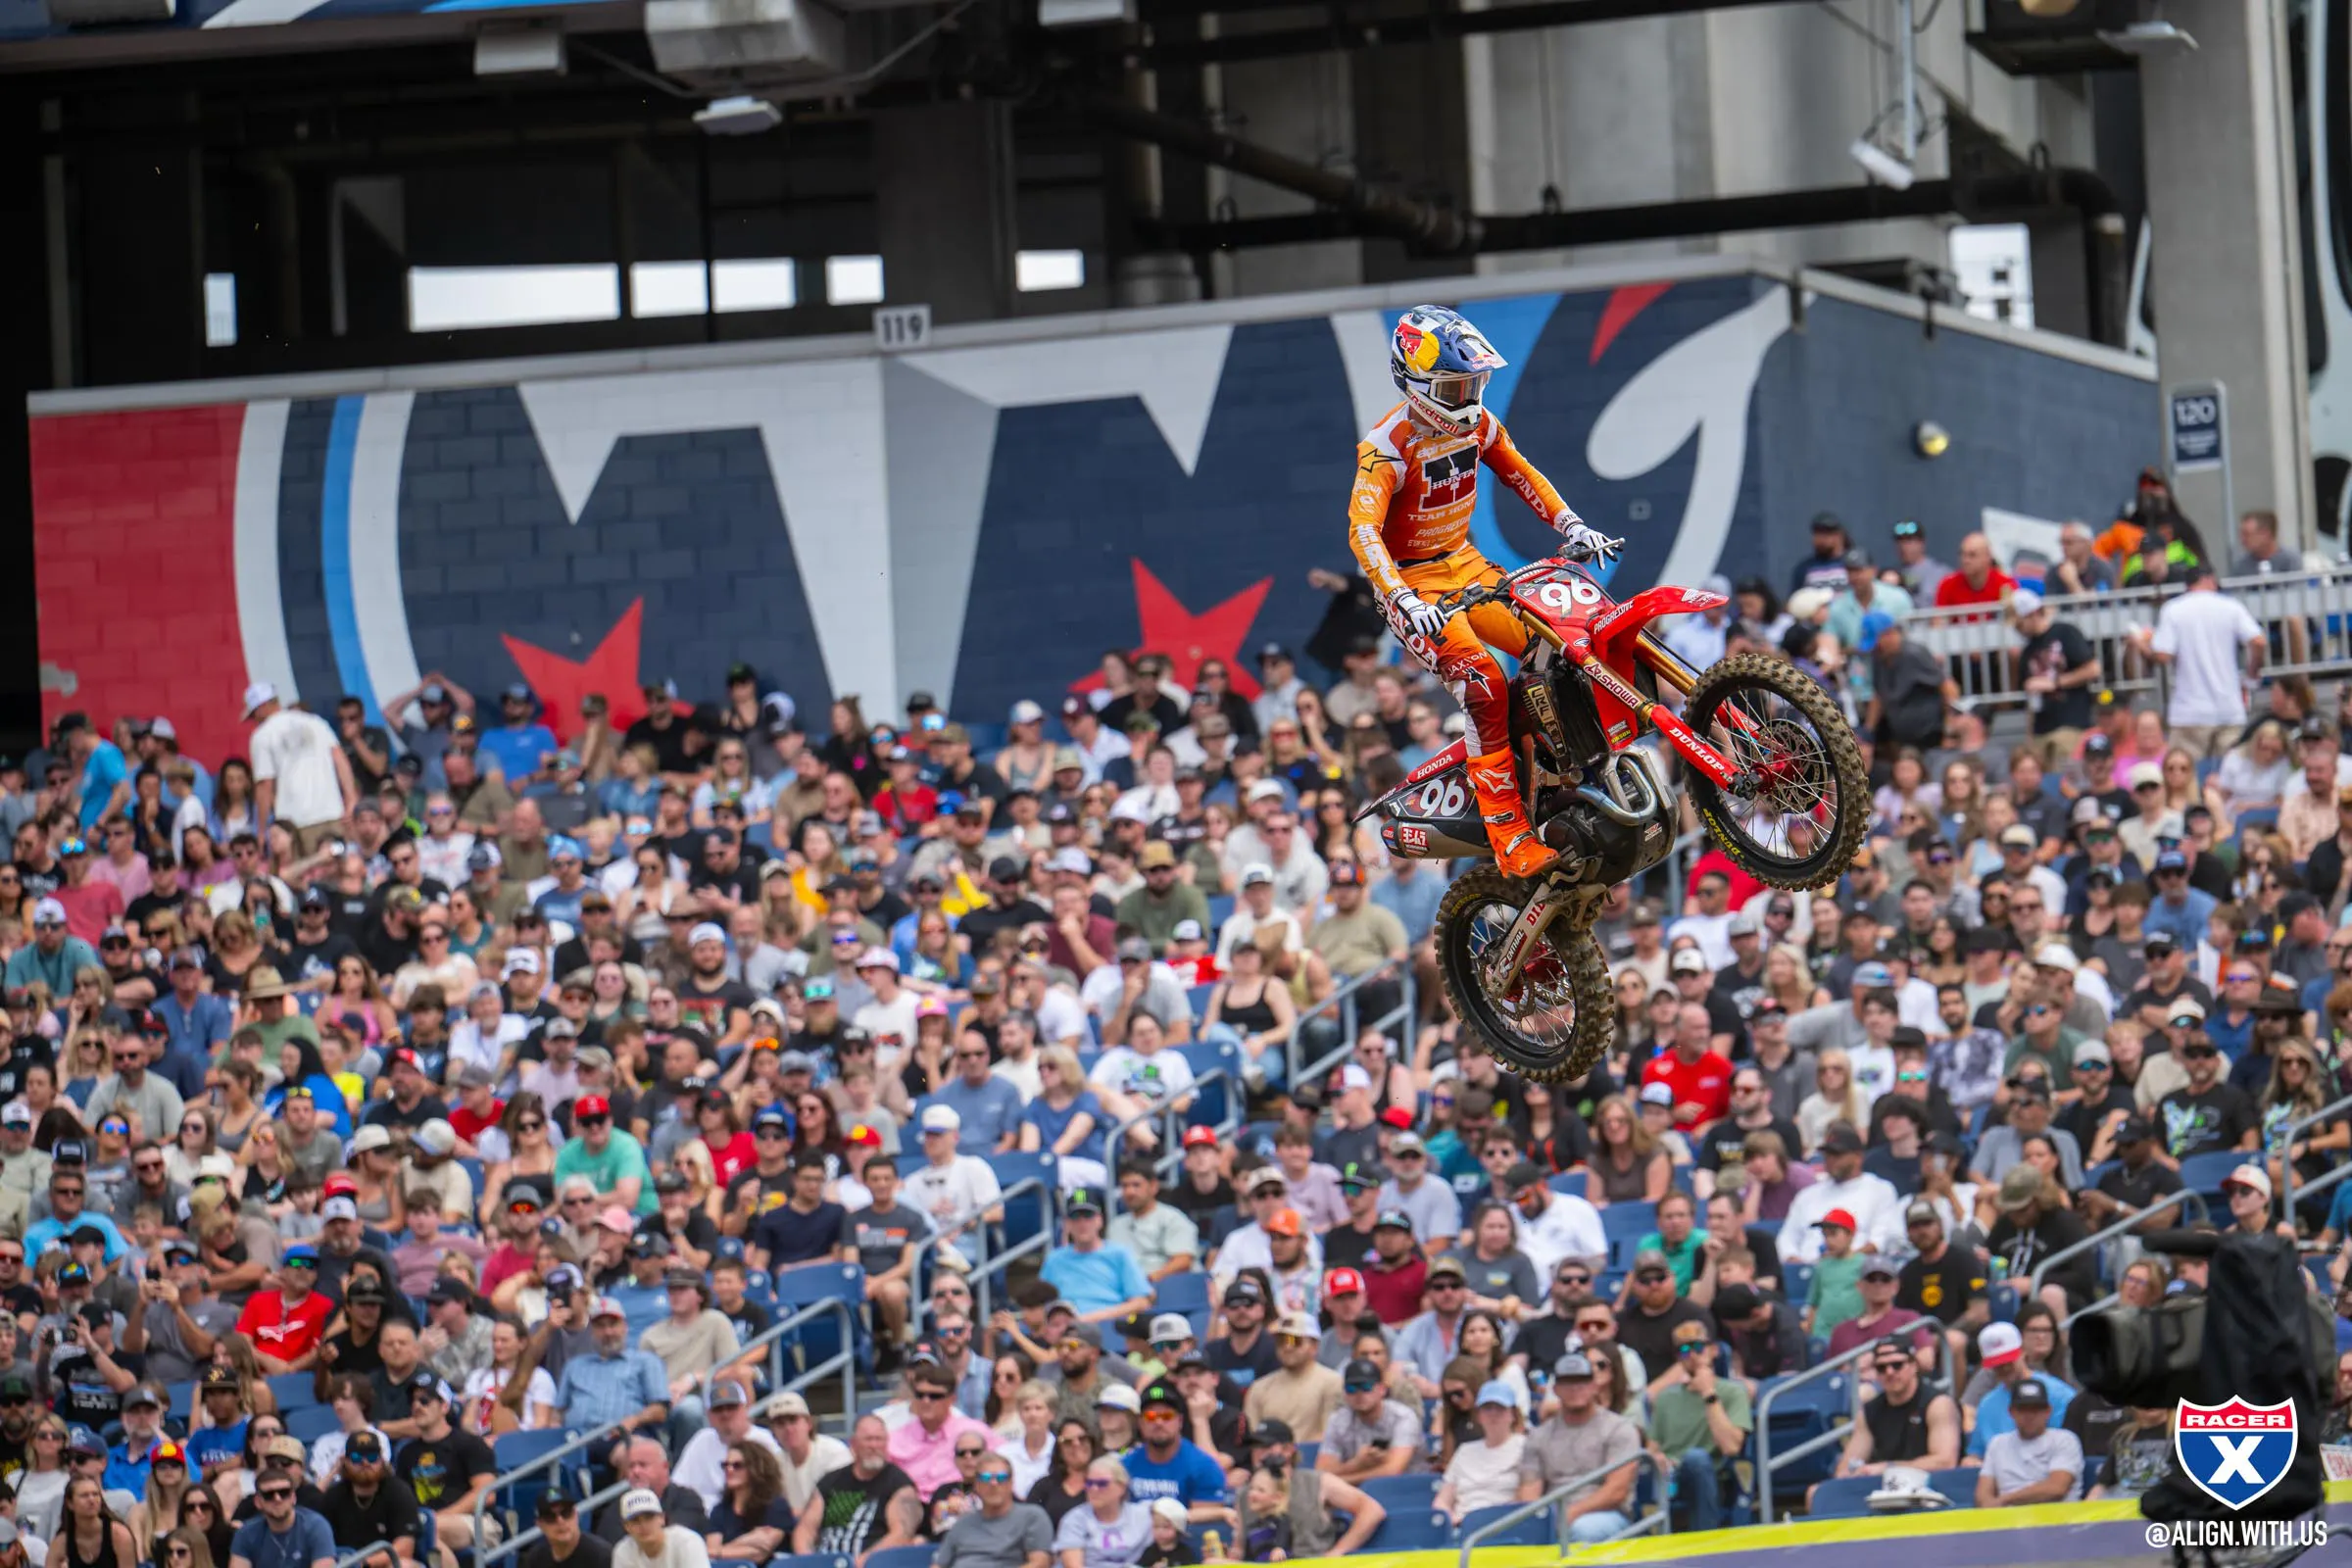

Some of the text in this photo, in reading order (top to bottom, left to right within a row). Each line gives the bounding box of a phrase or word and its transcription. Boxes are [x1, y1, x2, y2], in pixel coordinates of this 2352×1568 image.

[881, 314, 923, 344] 119
[2177, 397, 2216, 426] 120
[1407, 510, 1446, 521] TEAM
[1540, 573, 1601, 620] 96
[1593, 600, 1635, 635] PROGRESSIVE
[1600, 674, 1640, 708] SHOWA
[1417, 754, 1453, 779] HONDA
[1669, 726, 1725, 775] DUNLOP
[1420, 775, 1465, 817] 96
[1703, 808, 1741, 857] DUNLOP
